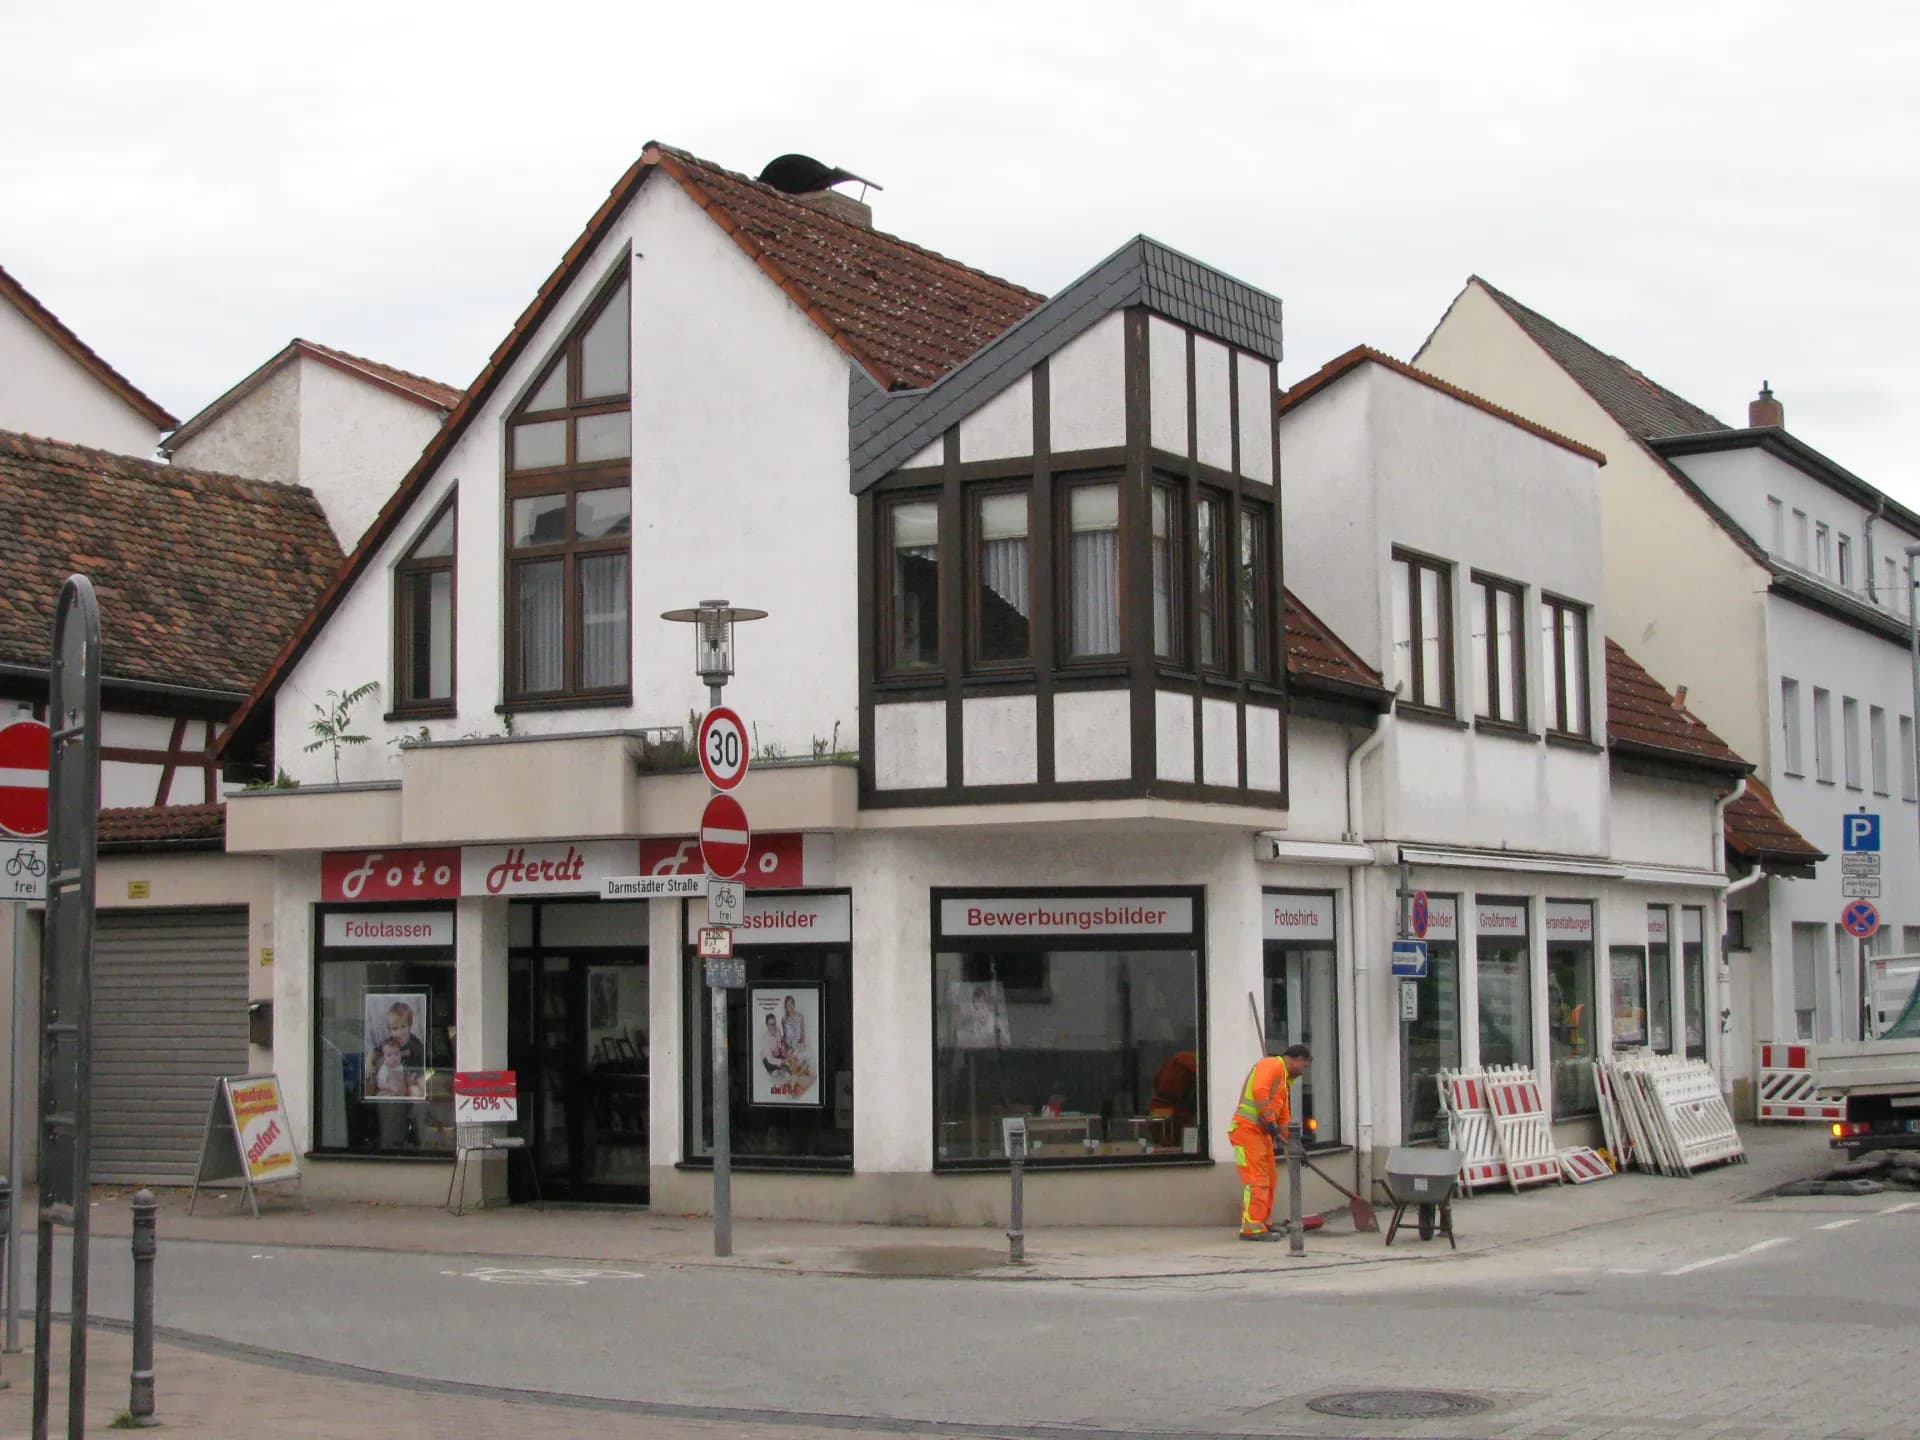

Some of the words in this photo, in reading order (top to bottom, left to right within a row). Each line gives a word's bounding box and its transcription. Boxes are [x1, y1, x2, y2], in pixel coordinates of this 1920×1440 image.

[709, 729, 739, 768] 30
[1851, 818, 1872, 847] P
[651, 840, 779, 876] Fo
[342, 853, 451, 898] Foto
[485, 846, 584, 894] Herdt
[15, 879, 37, 893] frei
[608, 878, 666, 895] Darmstädter
[667, 877, 699, 893] Straße
[719, 911, 732, 921] frei
[740, 911, 818, 929] ssbilder
[966, 907, 1168, 929] Bewerbungsbilder
[1274, 907, 1319, 927] Fotoshirts
[1479, 912, 1519, 929] Großformat
[345, 921, 432, 938] Fototassen
[472, 1096, 501, 1111] 50%
[247, 1119, 281, 1164] sofort
